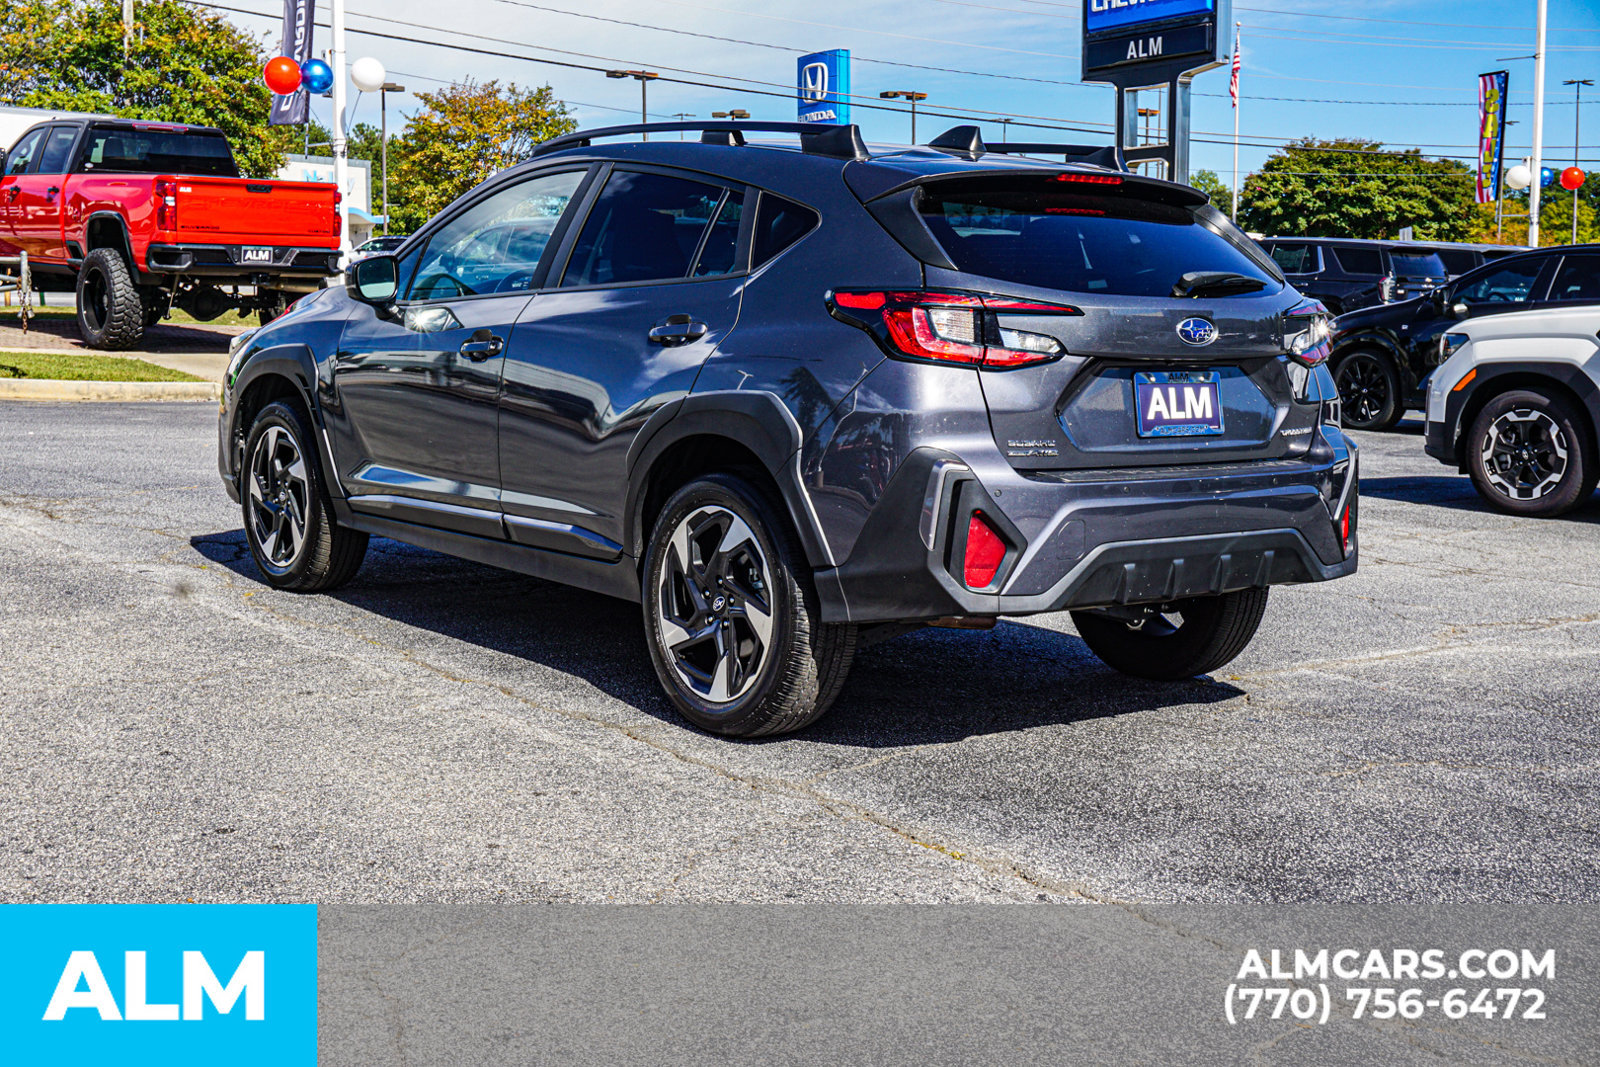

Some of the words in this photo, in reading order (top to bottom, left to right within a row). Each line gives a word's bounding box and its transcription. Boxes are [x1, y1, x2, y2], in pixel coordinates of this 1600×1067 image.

[1127, 36, 1163, 60] ALM
[798, 110, 837, 123] HONDA
[244, 250, 270, 261] ALM
[1168, 372, 1189, 383] ALM
[1147, 387, 1213, 420] ALM
